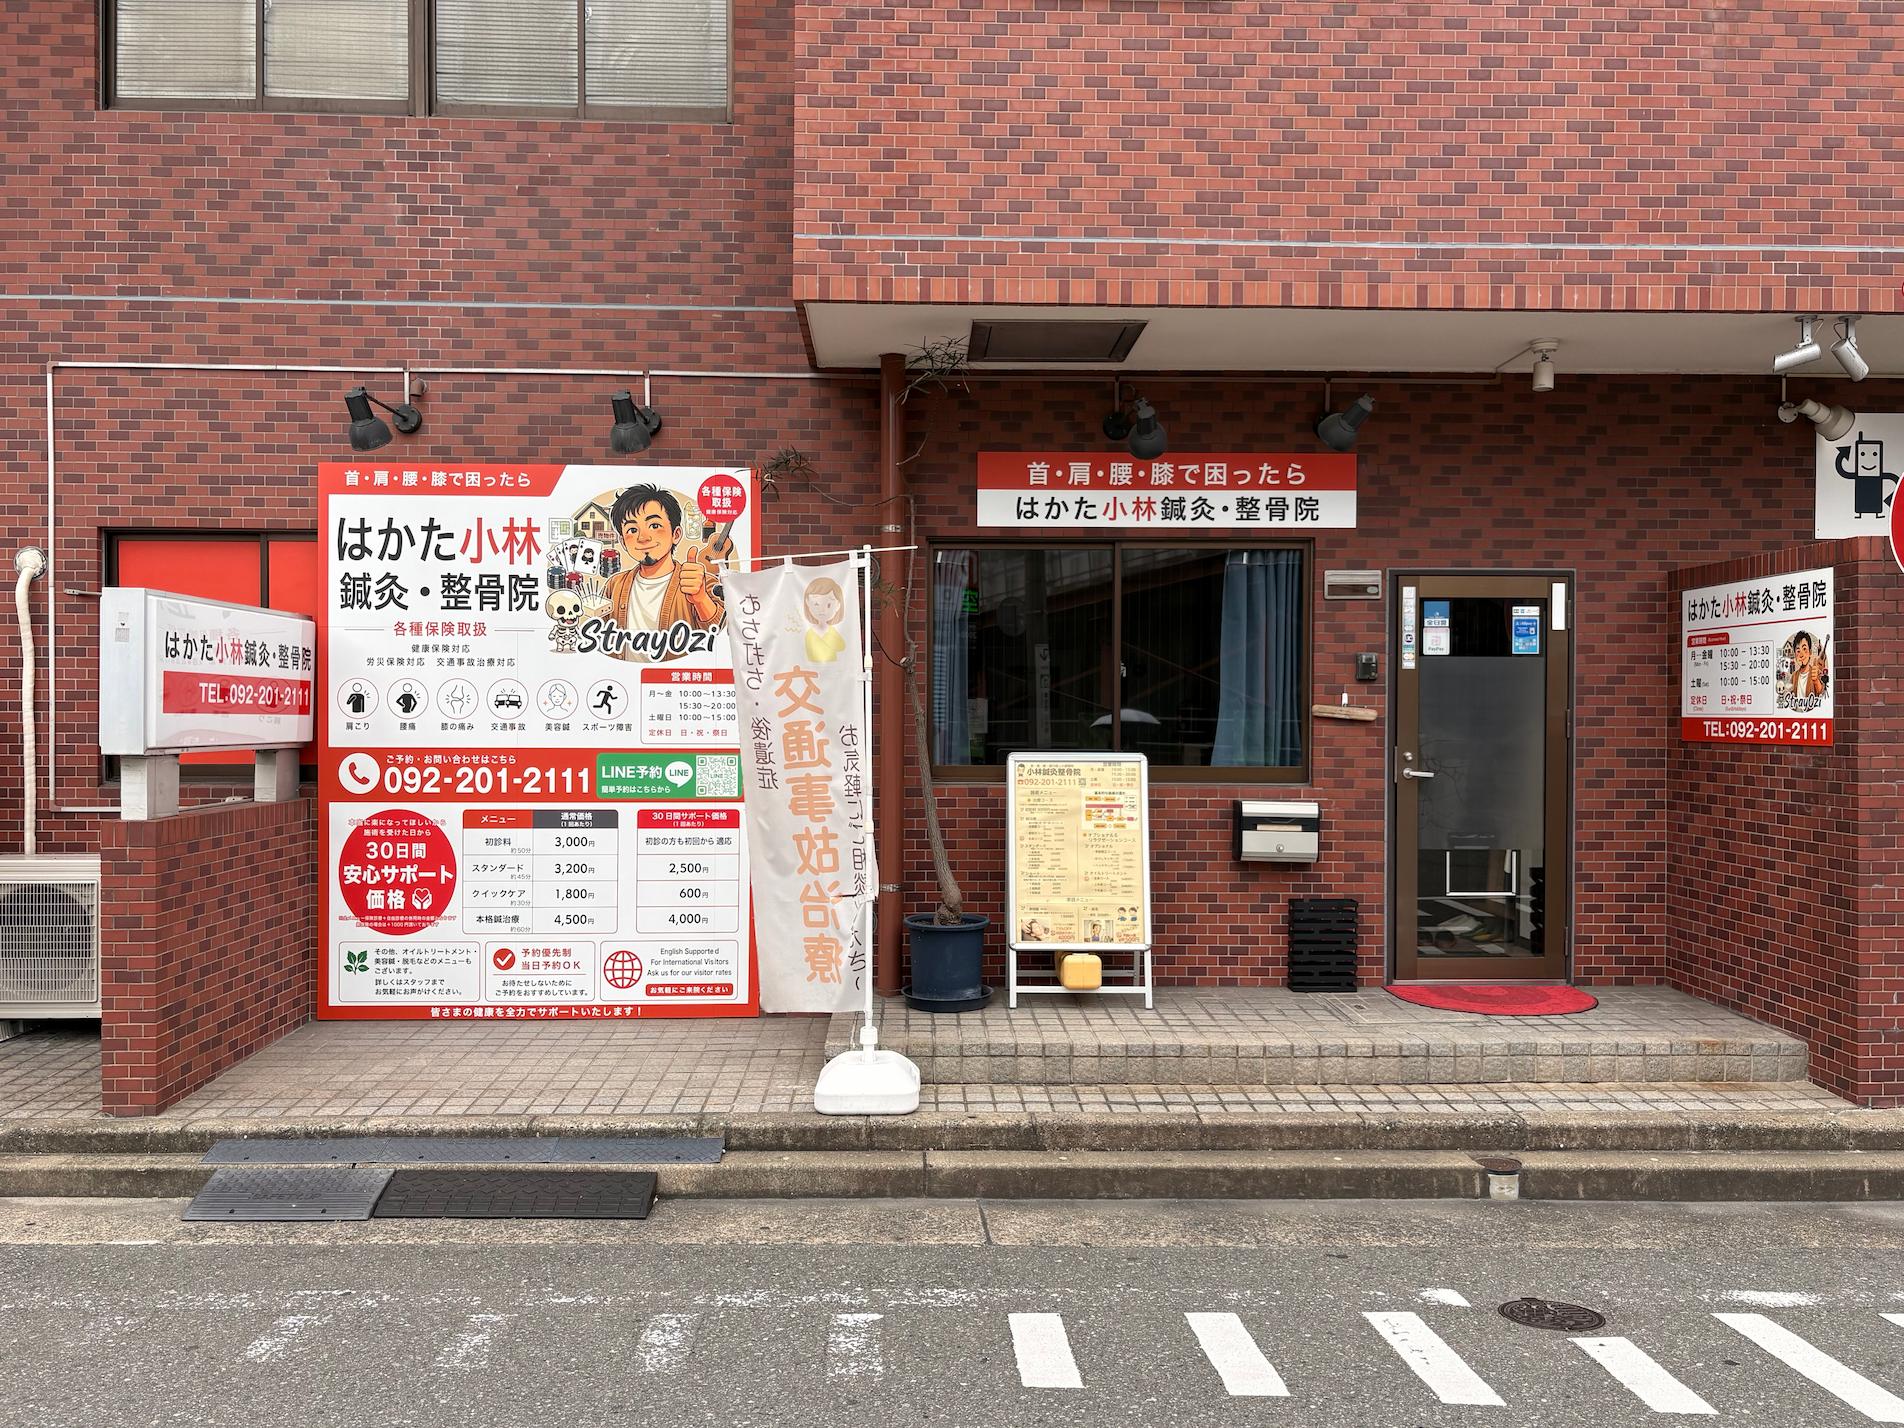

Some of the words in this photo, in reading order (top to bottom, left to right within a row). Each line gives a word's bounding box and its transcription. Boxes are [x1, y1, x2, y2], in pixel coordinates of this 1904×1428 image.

[344, 470, 532, 488] 首・肩・腰・膝で困ったら
[1026, 462, 1306, 486] 首・肩・腰・膝で困ったら
[702, 486, 742, 497] 各種保険
[712, 498, 732, 507] 取扱
[1016, 496, 1320, 522] はかた小林鍼灸・整骨院
[338, 517, 540, 565] はかた小林
[340, 572, 540, 611] 鍼灸・整骨院
[1688, 580, 1826, 622] はかた小林鍼灸・整骨院
[393, 622, 488, 637] 各種保険取扱
[578, 618, 717, 660] StrayOzi
[165, 630, 312, 672] はかた小林鍼灸・整骨院
[412, 644, 470, 654] 健康保険対応
[1720, 648, 1738, 657] 10:00
[1750, 646, 1770, 655] 13:30
[366, 657, 425, 667] 労災保険対応
[436, 658, 516, 667] 交通事故治療対応
[1720, 661, 1738, 670] 15:30
[1749, 659, 1770, 669] 20:00
[671, 672, 713, 681] 営業時間
[1720, 677, 1738, 686] 10:00
[1750, 676, 1770, 685] 15:00
[1784, 694, 1822, 709] StrayOzi
[346, 722, 370, 731] 肩こり
[400, 722, 417, 731] 腰痛
[440, 722, 474, 731] 膝の痛み
[491, 723, 526, 732] 交通事故
[545, 723, 570, 732] 美容鍼
[582, 723, 632, 732] スポーツ障害
[1703, 721, 1827, 740] TEL:092-201-2111
[386, 755, 516, 764] ご予約・お問い合わせはこちら
[602, 766, 662, 779] LINE予約
[384, 767, 589, 794] 092-201-2111
[602, 785, 671, 794] 簡単予約はこちらから
[480, 815, 516, 823] メニュー
[485, 838, 511, 846] 初診料
[554, 836, 595, 849] 3,000円
[366, 842, 427, 859] 30日間
[472, 864, 524, 872] スタンダード
[554, 863, 595, 874] 3,200円
[669, 862, 709, 874] 2,500円
[343, 864, 454, 884] 安心サポート
[366, 889, 406, 909] 価格
[472, 890, 526, 898] クイックケア
[555, 889, 595, 900] 1,800円
[679, 888, 708, 899] 600円
[476, 915, 519, 923] 本格鍼治療
[554, 914, 595, 926] 4,500円
[668, 914, 708, 925] 4,000円
[521, 948, 572, 957] 予約優先制
[660, 948, 683, 956] English
[431, 1007, 642, 1017] 皆さまの健康を全力でサポートいたします！
